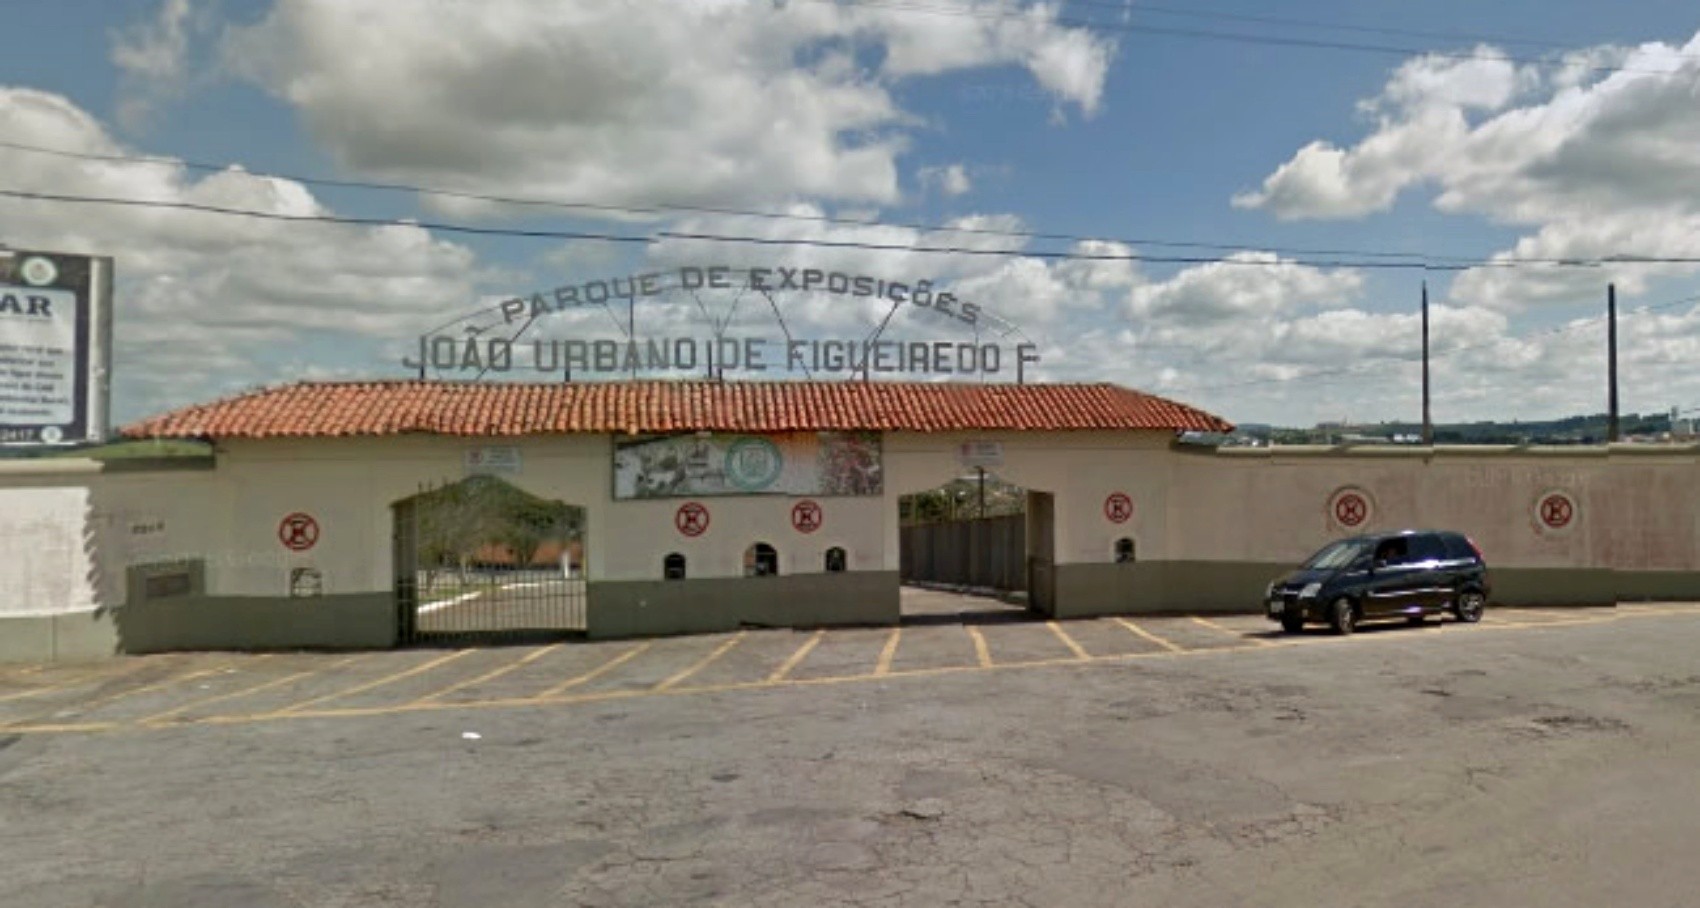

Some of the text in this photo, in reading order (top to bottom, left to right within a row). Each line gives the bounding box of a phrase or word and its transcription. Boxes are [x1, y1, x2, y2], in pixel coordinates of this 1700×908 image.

[501, 266, 982, 325] PARQUE DE EXPOSIÇÕES
[402, 325, 513, 372] JOÃO
[533, 336, 697, 373] URBANO
[718, 336, 768, 371] DE
[787, 338, 1000, 374] FIGUEIREDO
